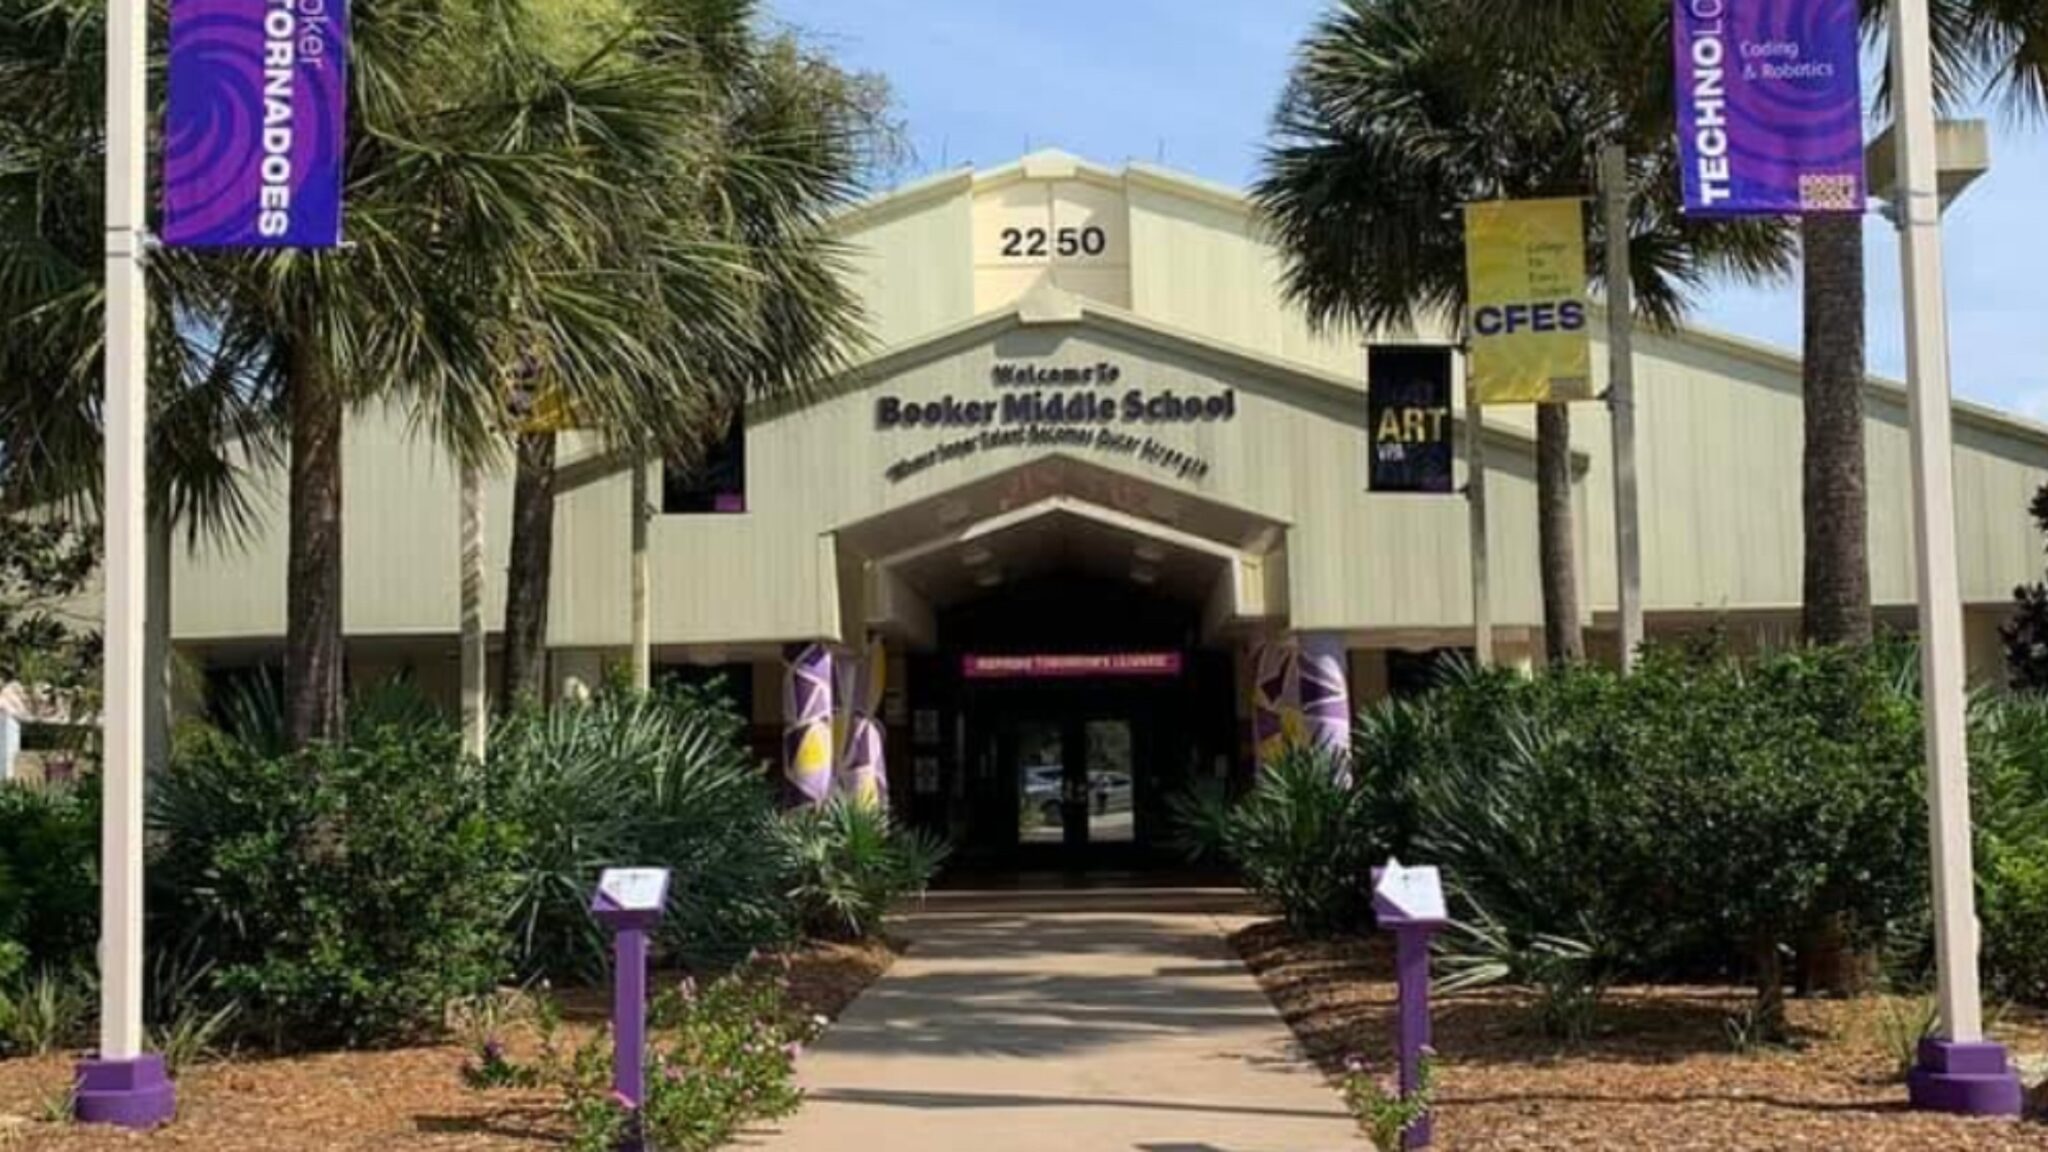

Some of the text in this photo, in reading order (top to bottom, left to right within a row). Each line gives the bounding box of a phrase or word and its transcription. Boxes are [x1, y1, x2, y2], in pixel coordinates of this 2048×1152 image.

[1740, 41, 1799, 60] Coding
[1762, 62, 1834, 79] Robotics
[1001, 226, 1105, 257] 2250
[1474, 301, 1586, 336] CFES
[991, 363, 1119, 388] Welcome To
[876, 389, 1235, 429] Booker Middle School
[1377, 407, 1448, 442] ART
